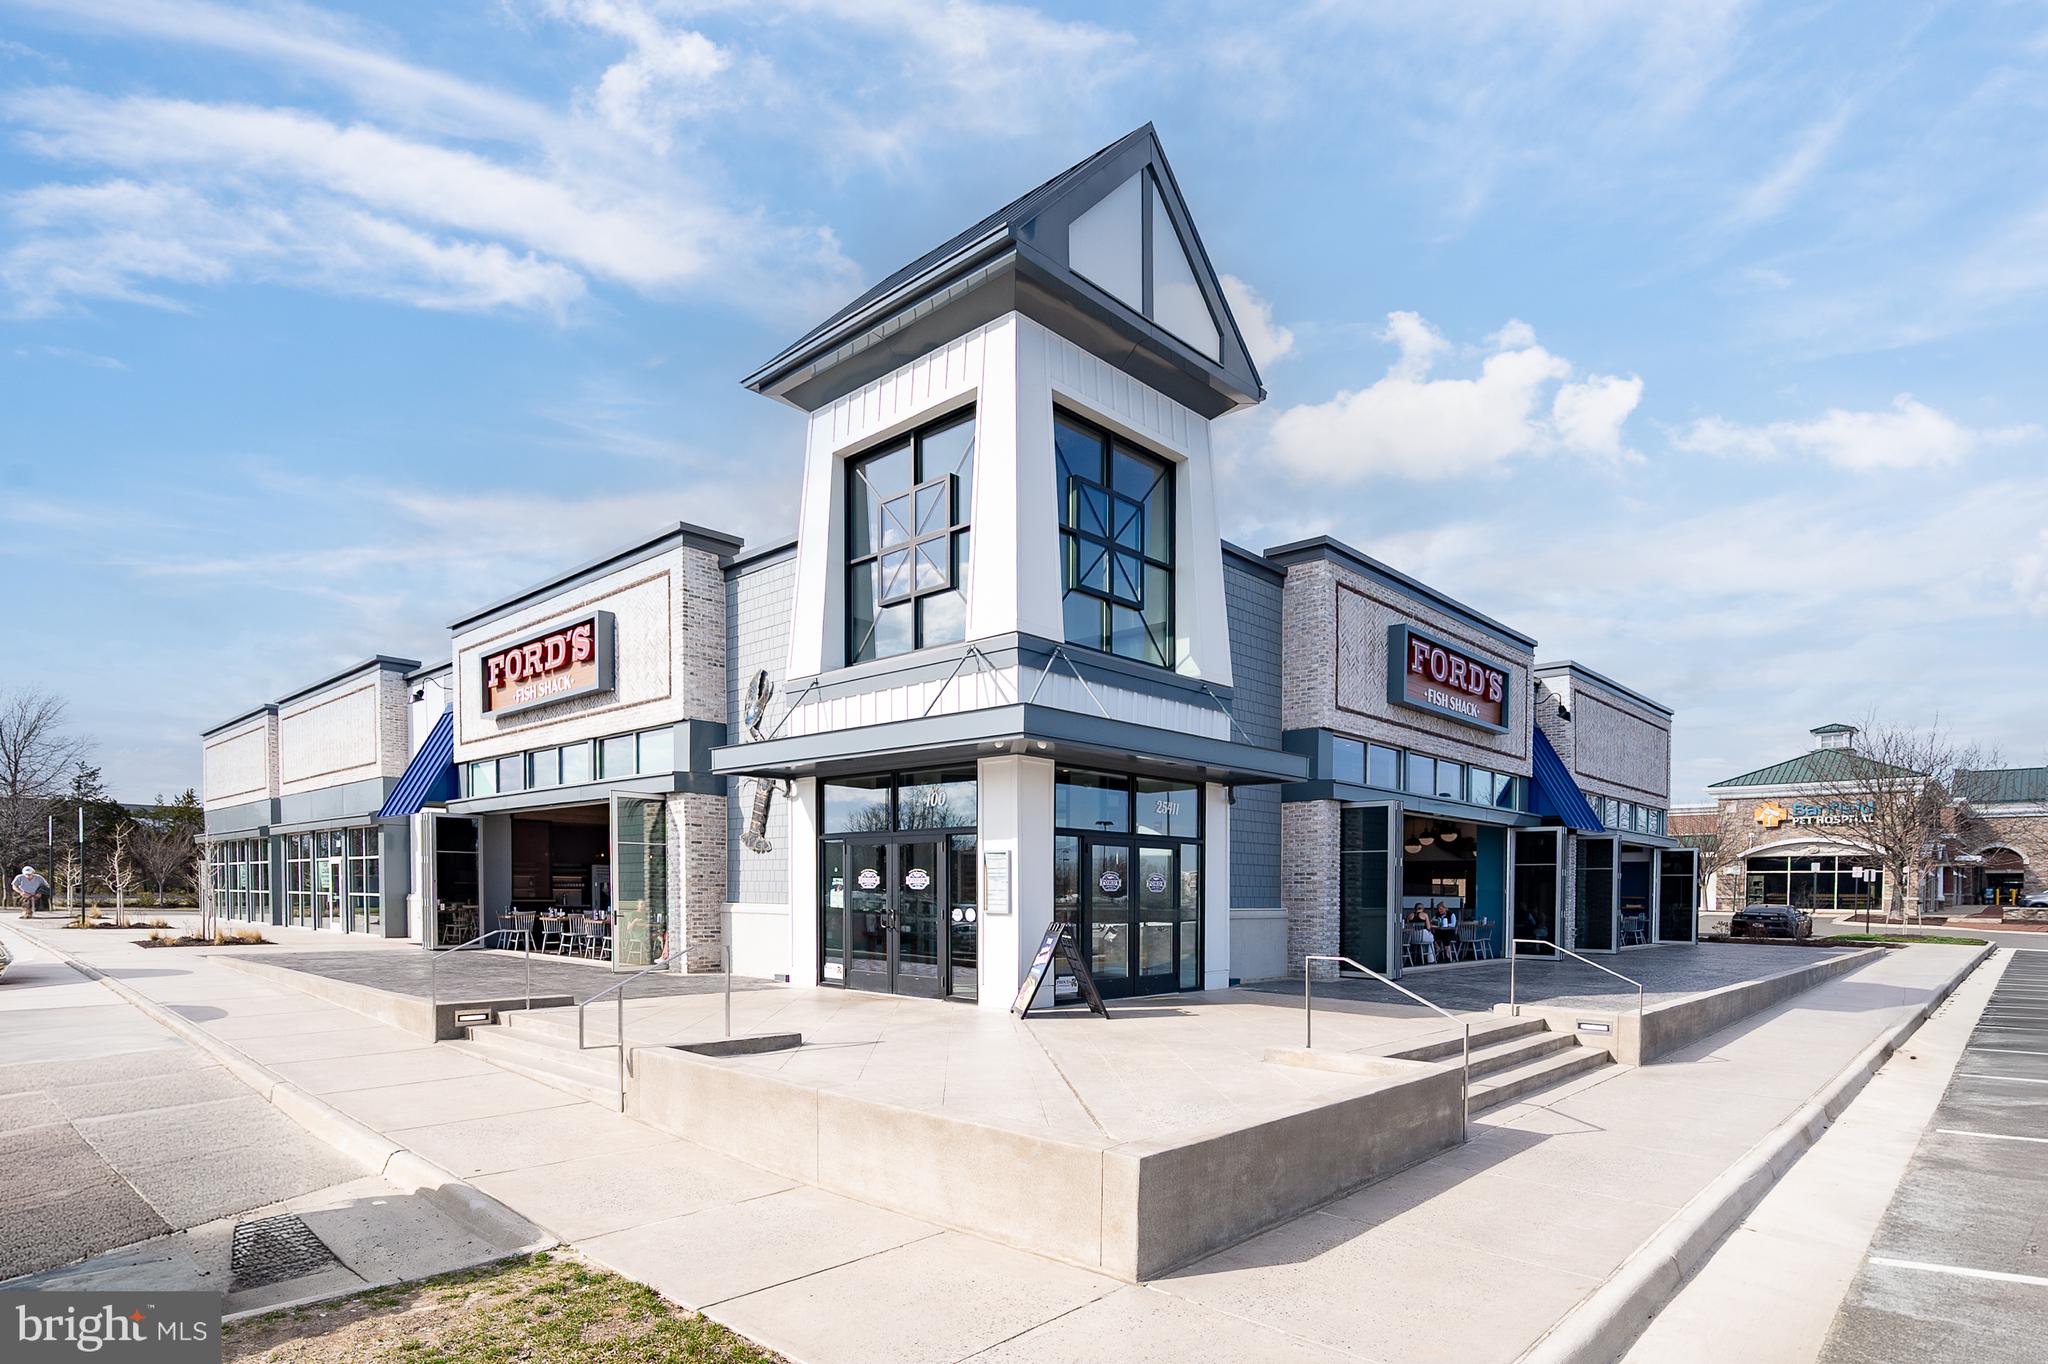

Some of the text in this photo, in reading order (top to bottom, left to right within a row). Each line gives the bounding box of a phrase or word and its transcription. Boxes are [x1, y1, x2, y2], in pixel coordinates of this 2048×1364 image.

[487, 624, 592, 688] FORD'S
[1411, 638, 1503, 703] FORD'S
[516, 674, 572, 704] FISH SHACK
[1427, 688, 1478, 718] FISH SHACK
[926, 791, 947, 807] 100
[1156, 800, 1180, 816] 25411
[1792, 816, 1813, 825] PET
